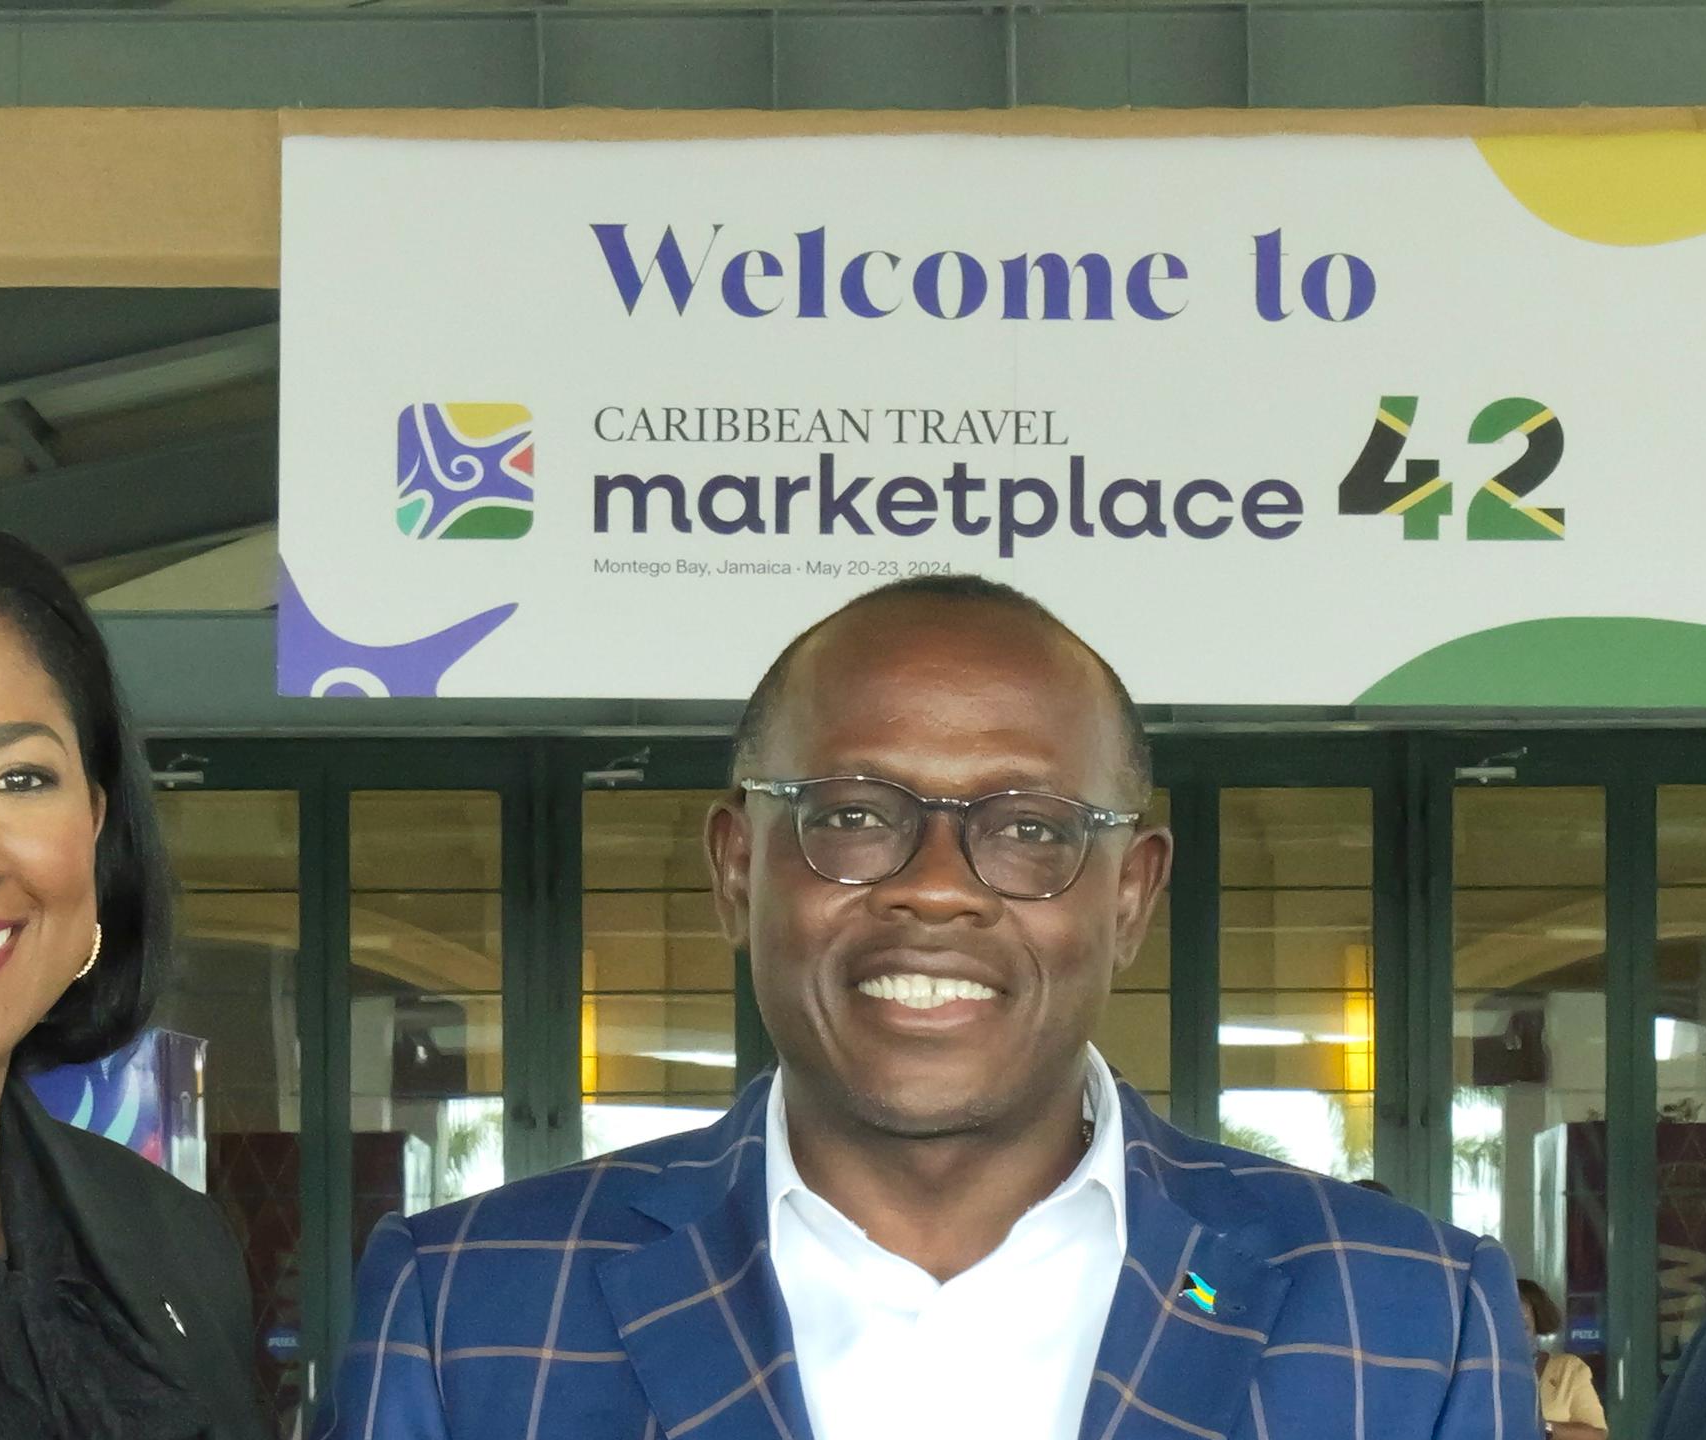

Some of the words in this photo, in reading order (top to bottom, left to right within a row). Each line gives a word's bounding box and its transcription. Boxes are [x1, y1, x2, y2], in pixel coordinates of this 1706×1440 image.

[588, 223, 1188, 321] Welcome
[1250, 228, 1376, 323] to
[594, 406, 874, 444] CARIBBEAN
[884, 407, 1070, 446] TRAVEL
[1338, 395, 1565, 541] 42
[593, 452, 1304, 558] marketplace
[593, 559, 671, 577] Montego
[676, 559, 711, 577] Bay,
[716, 559, 791, 576] Jamaica
[806, 560, 842, 577] May
[847, 560, 903, 578] 20-23,
[908, 561, 953, 576] 2024
